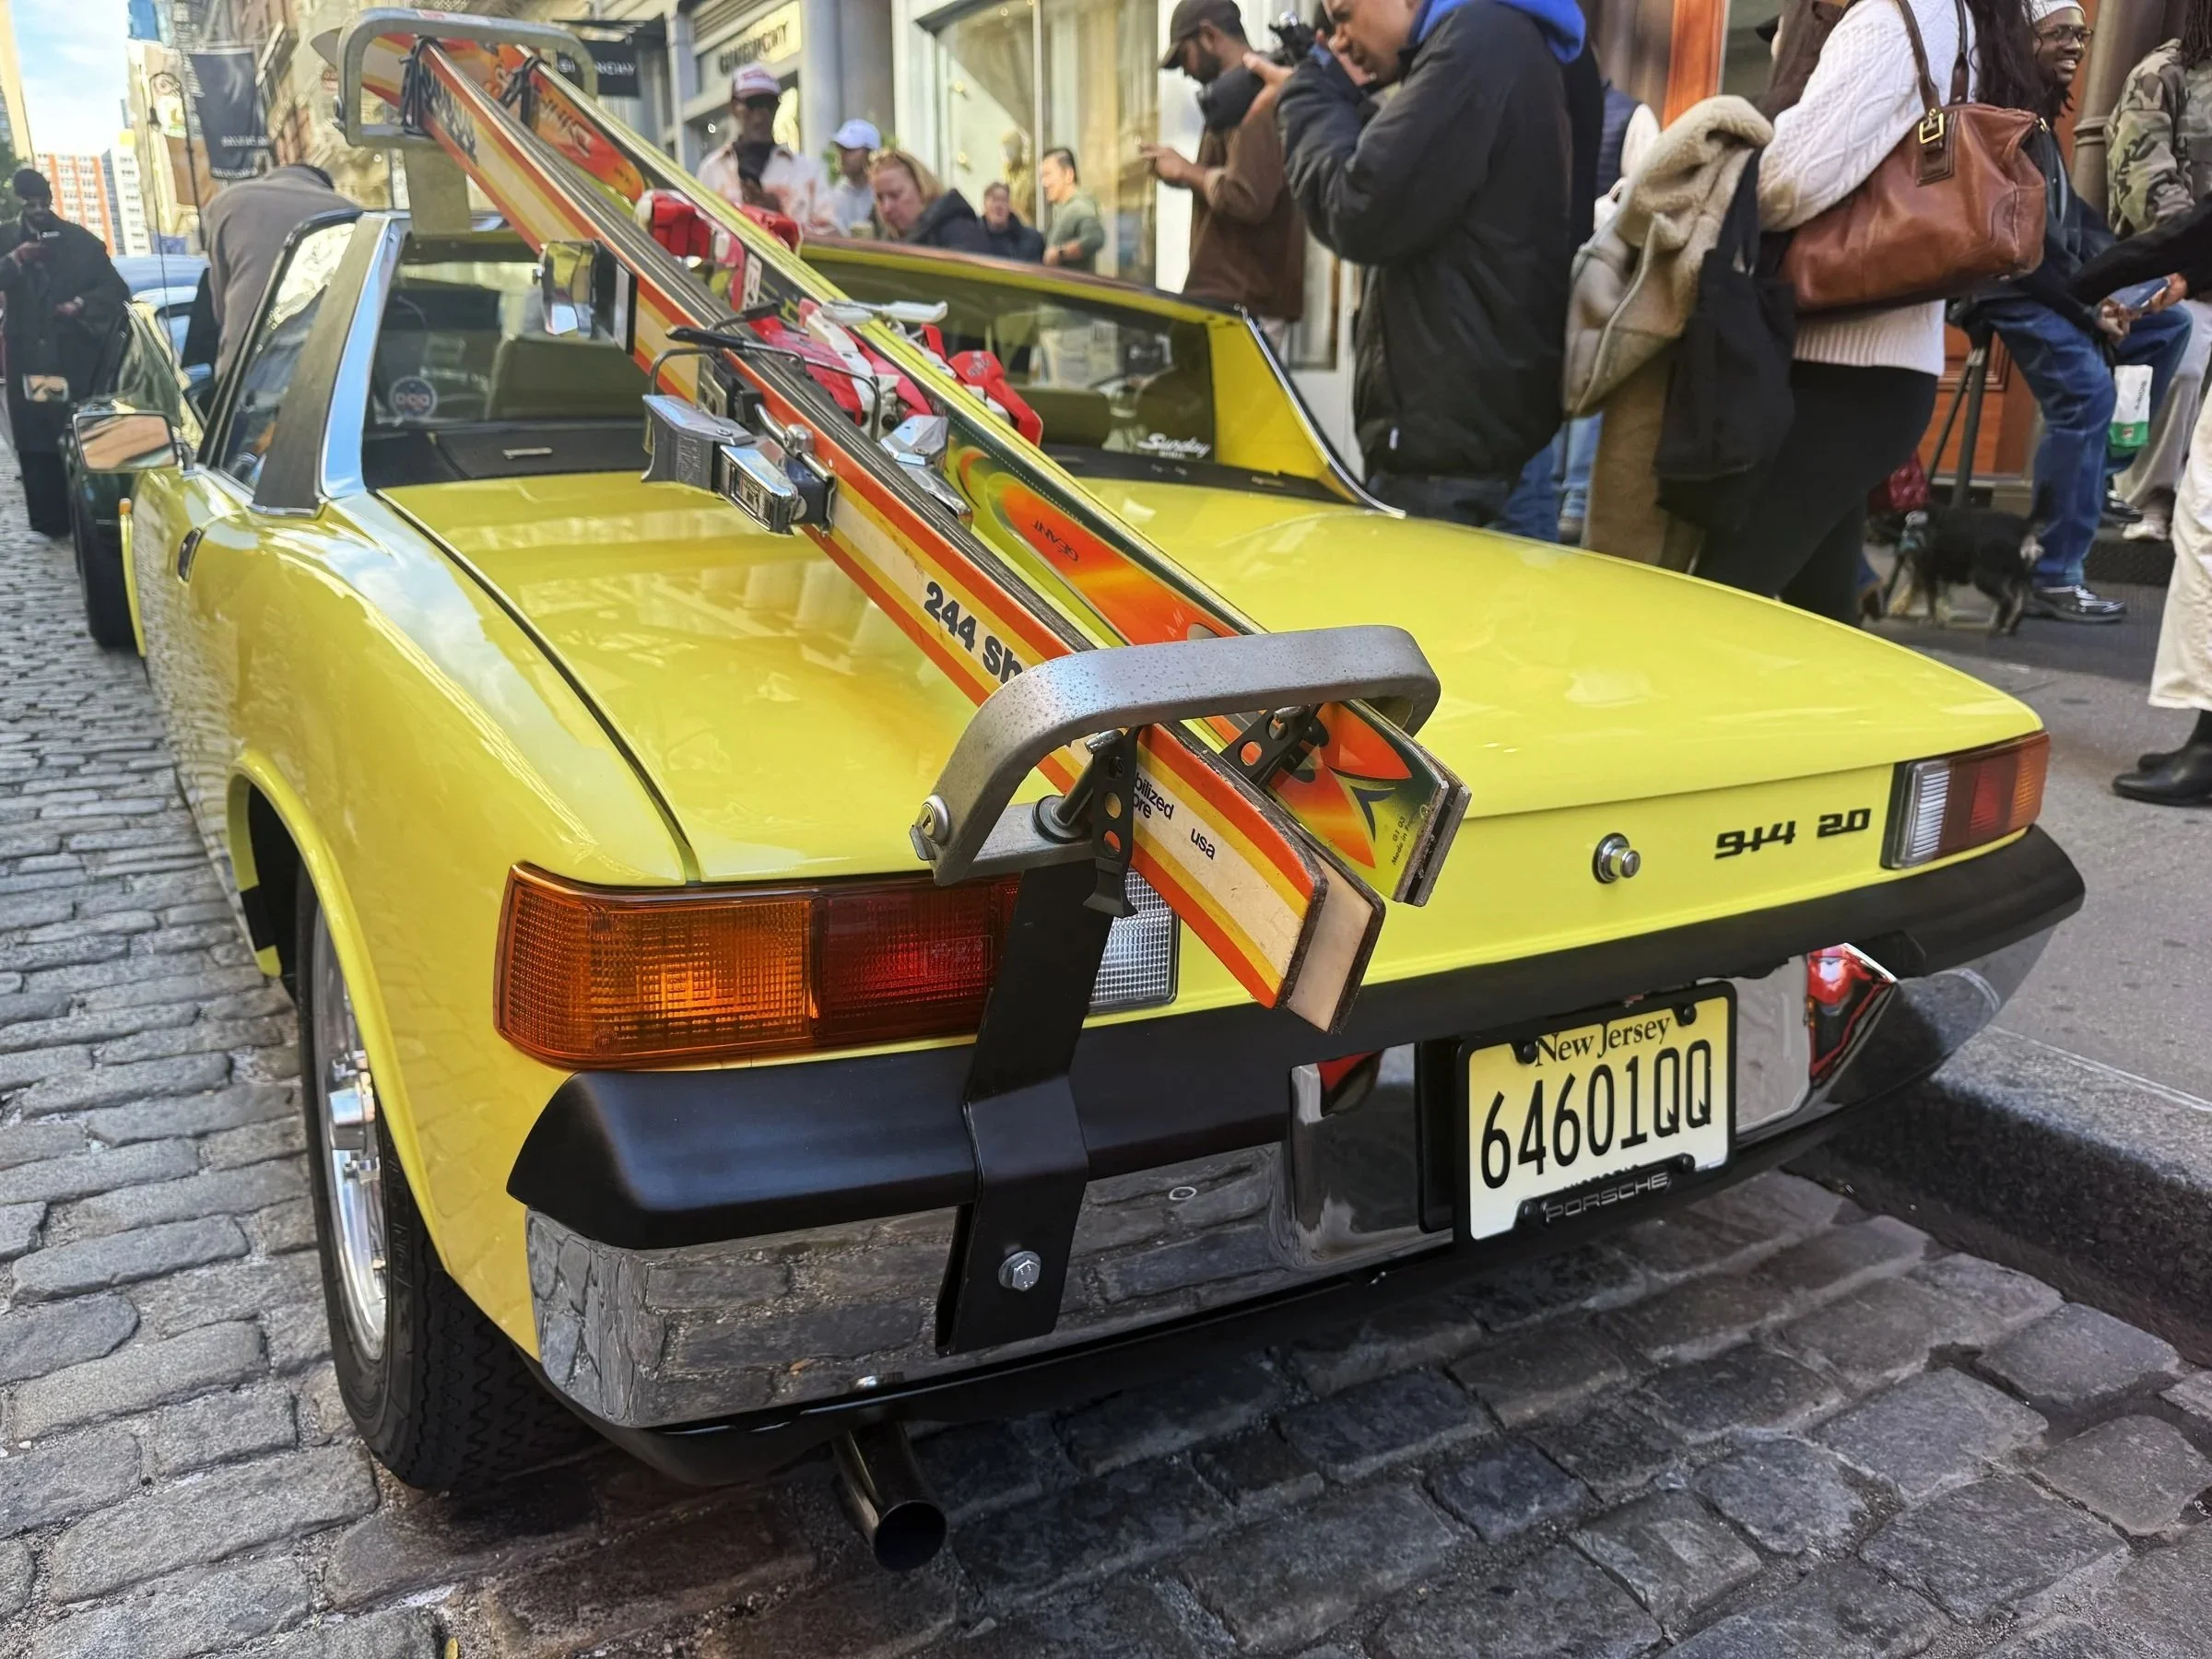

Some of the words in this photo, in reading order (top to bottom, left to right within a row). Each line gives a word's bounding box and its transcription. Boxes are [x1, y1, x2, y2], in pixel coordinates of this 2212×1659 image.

[1136, 432, 1211, 459] Sunday
[924, 581, 977, 653] 244
[1190, 828, 1217, 861] usa
[1391, 842, 1405, 866] Made
[1402, 832, 1407, 841] in
[1714, 820, 1796, 860] 914
[1535, 1033, 1594, 1067] New
[1597, 1017, 1671, 1059] Jersey
[1480, 1039, 1712, 1189] 64601QQ
[1546, 1171, 1672, 1222] PORSCHE
